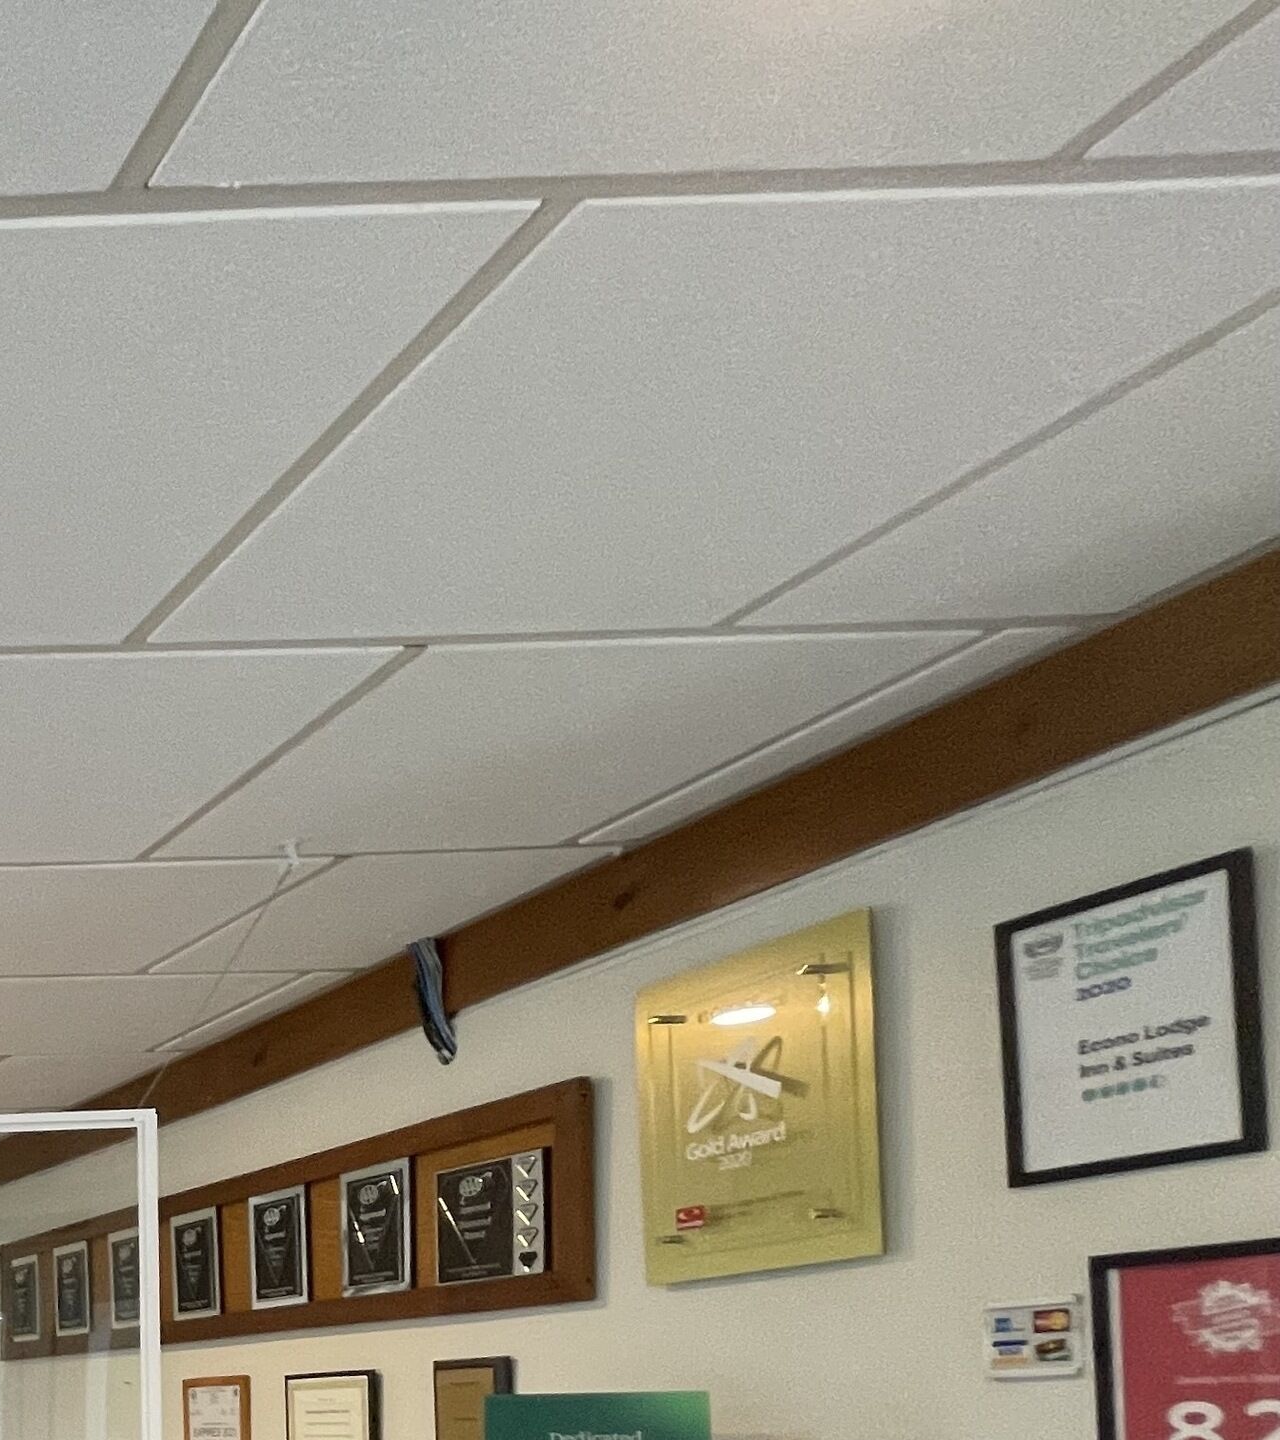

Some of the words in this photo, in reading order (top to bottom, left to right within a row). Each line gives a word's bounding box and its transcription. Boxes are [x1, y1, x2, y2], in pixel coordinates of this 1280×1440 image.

[1076, 976, 1131, 1001] 2020
[1079, 1032, 1139, 1055] Econo
[1143, 1015, 1210, 1040] Lodge
[1080, 1063, 1109, 1078] Inn
[1114, 1056, 1126, 1071] &
[1132, 1044, 1195, 1066] Suites
[687, 1135, 725, 1160] Gold
[726, 1121, 786, 1152] Award
